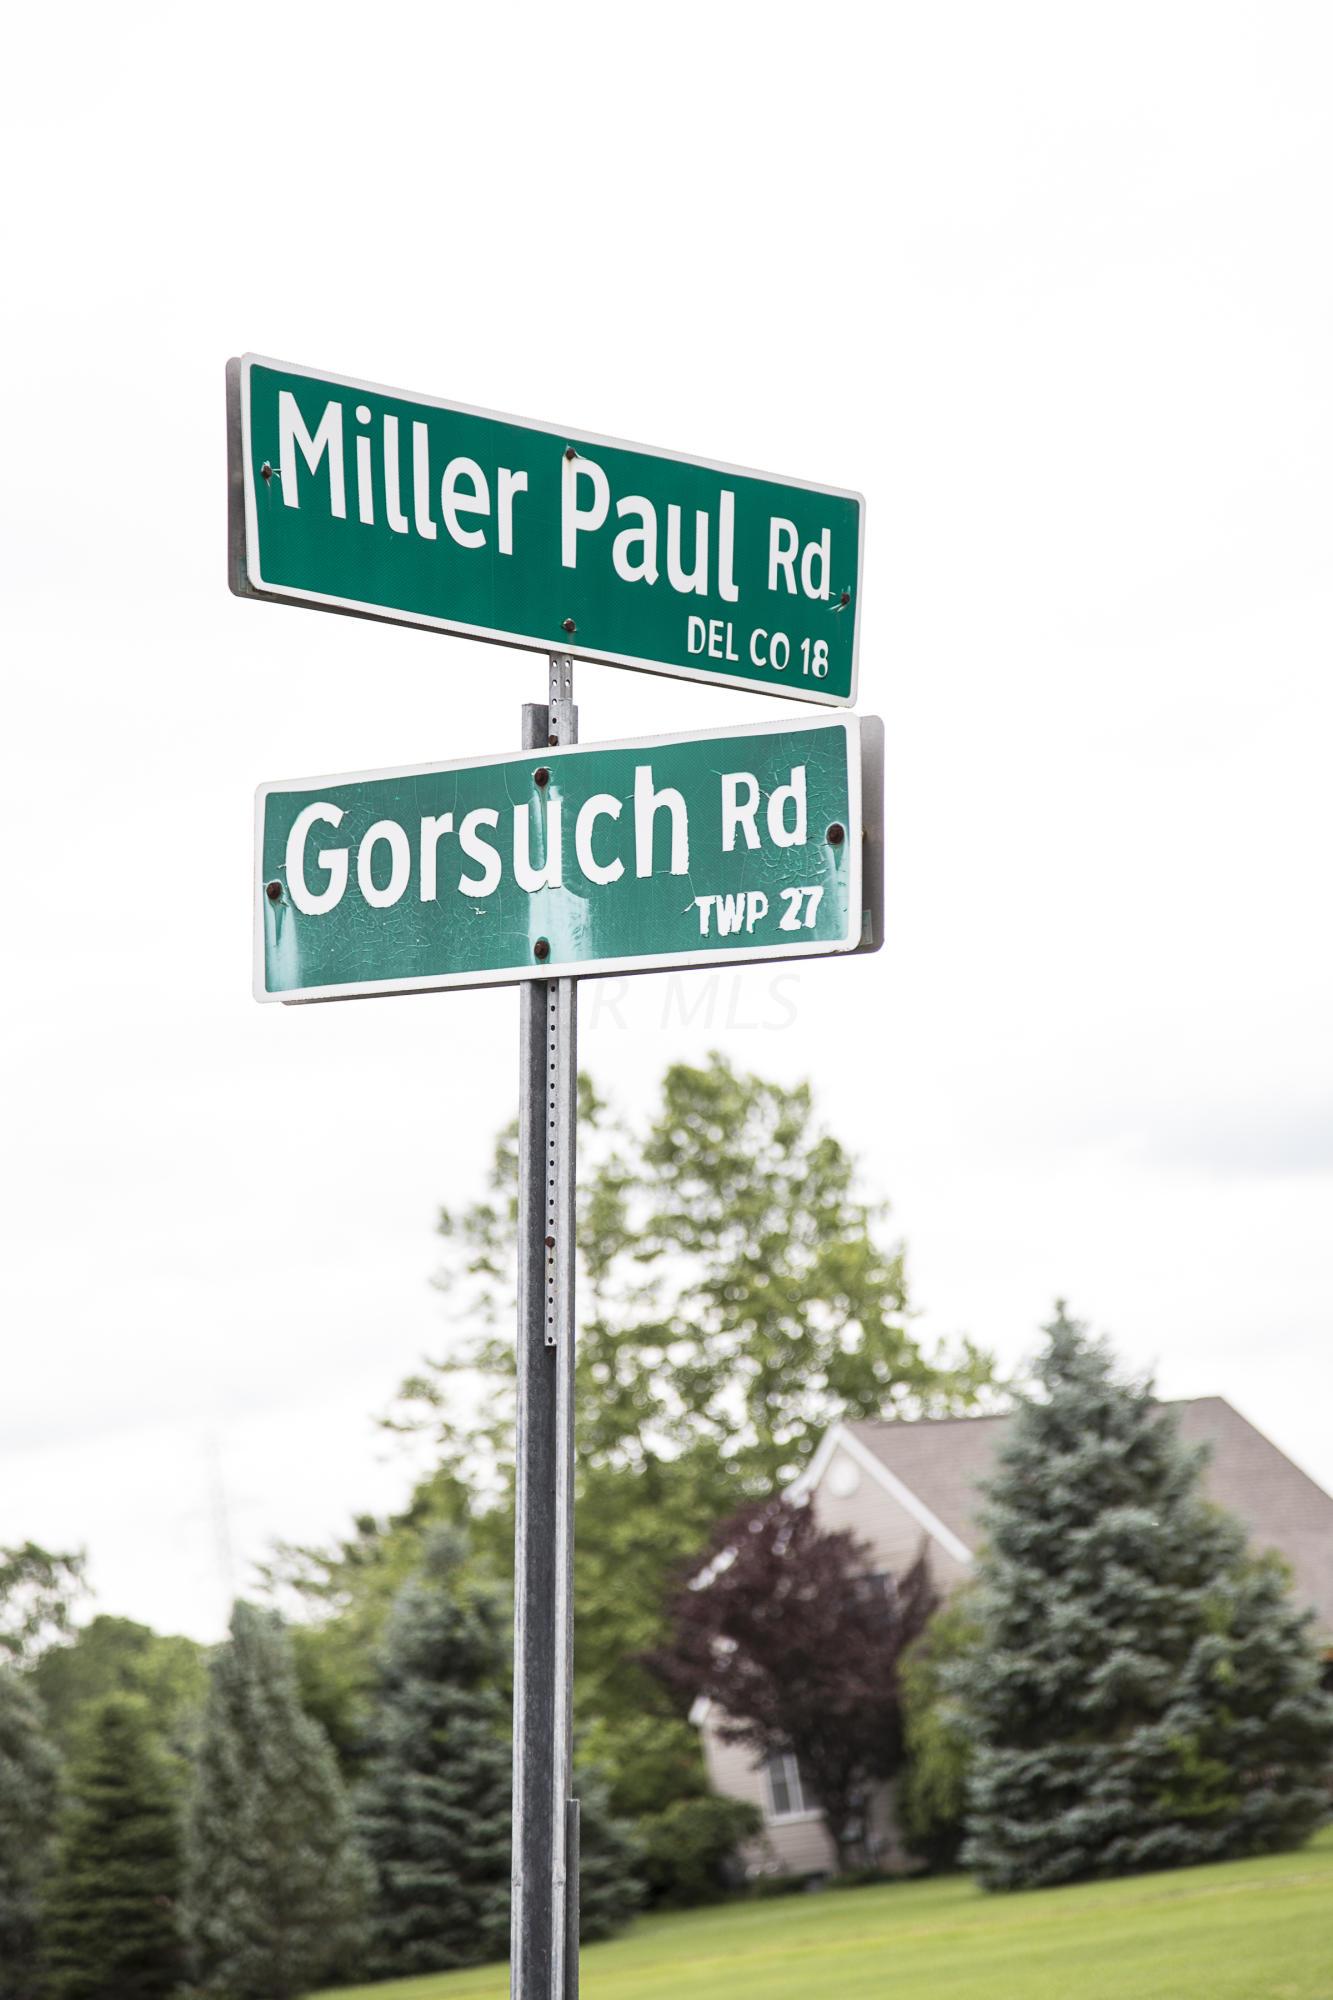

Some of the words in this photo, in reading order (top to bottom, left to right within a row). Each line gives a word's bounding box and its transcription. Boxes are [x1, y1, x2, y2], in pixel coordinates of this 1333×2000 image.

[277, 389, 530, 556] Miller
[560, 449, 741, 602] Paul
[767, 517, 832, 600] Rd
[687, 615, 740, 662] DEL
[749, 628, 791, 670] CO
[800, 638, 830, 678] 18
[283, 766, 690, 916] Gorsuch
[720, 766, 808, 853] Rd
[694, 891, 768, 937] TWP
[779, 886, 824, 931] 27
